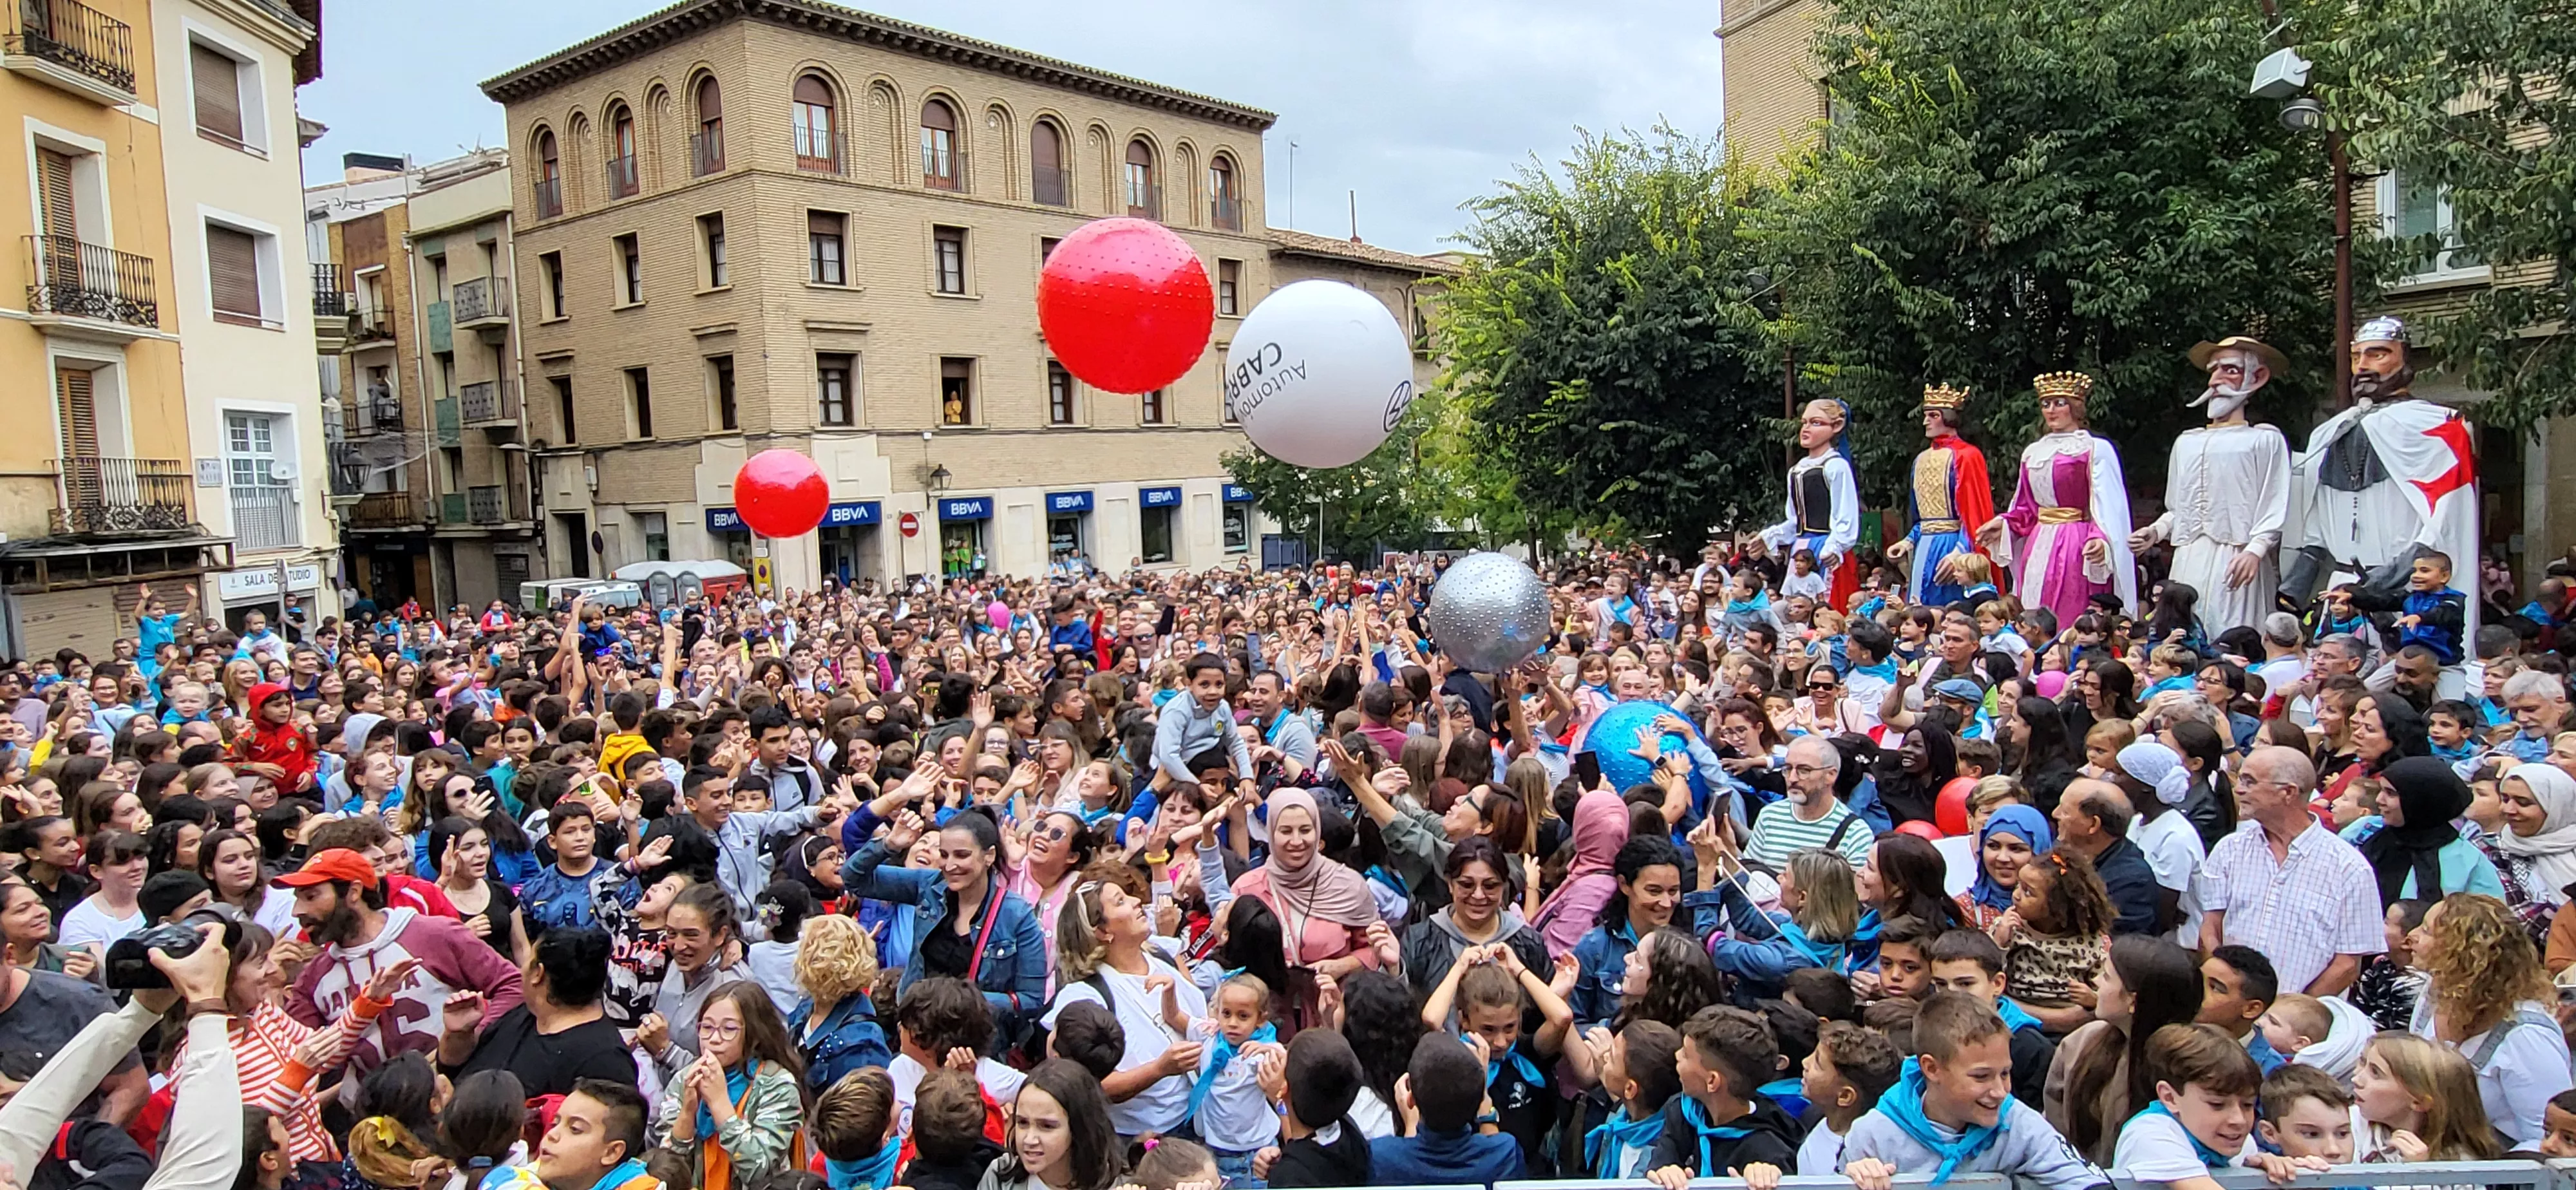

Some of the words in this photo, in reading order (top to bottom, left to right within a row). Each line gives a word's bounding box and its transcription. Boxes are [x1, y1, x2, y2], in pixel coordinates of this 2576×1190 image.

[1229, 342, 1282, 399] CABR
[1056, 495, 1084, 509] BBVA
[1148, 490, 1174, 503] BBVA
[831, 505, 869, 522] BBVA
[951, 501, 983, 516] BBVA
[714, 513, 739, 526] BBVA
[244, 574, 265, 587] SALA
[288, 569, 310, 581] TUDIO
